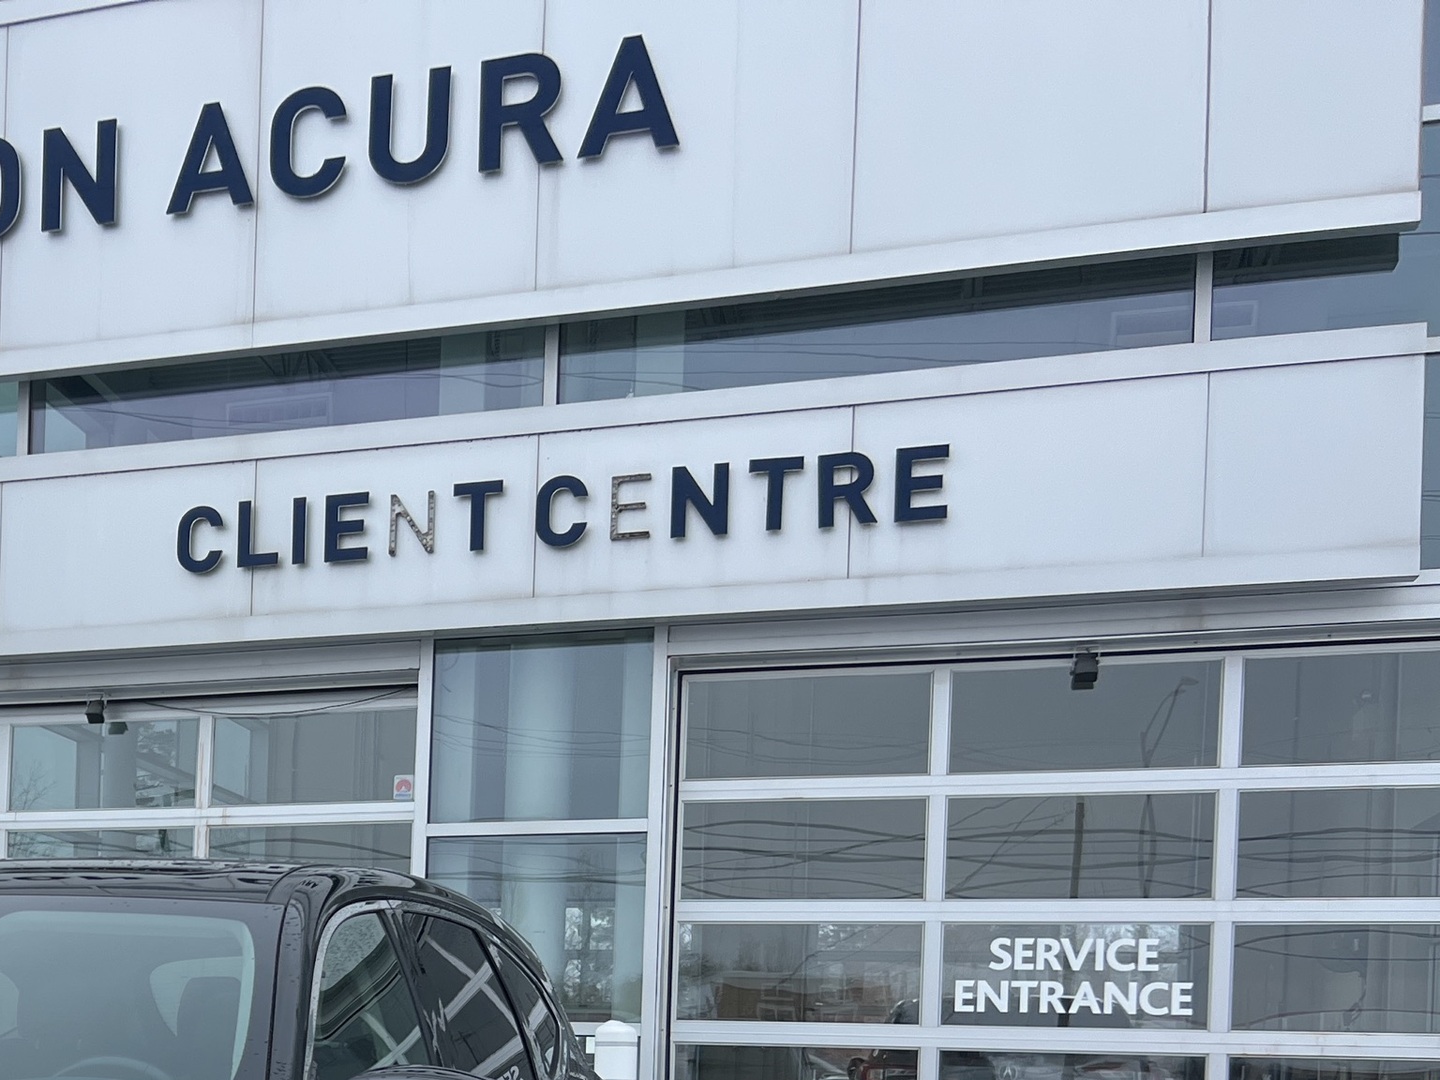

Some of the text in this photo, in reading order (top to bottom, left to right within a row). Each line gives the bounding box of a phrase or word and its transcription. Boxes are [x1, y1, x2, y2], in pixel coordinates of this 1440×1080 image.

[166, 34, 681, 214] ACURA
[176, 443, 951, 574] CLIENT CENTRE
[988, 937, 1161, 972] SERVICE
[954, 980, 1194, 1016] ENTRANCE
